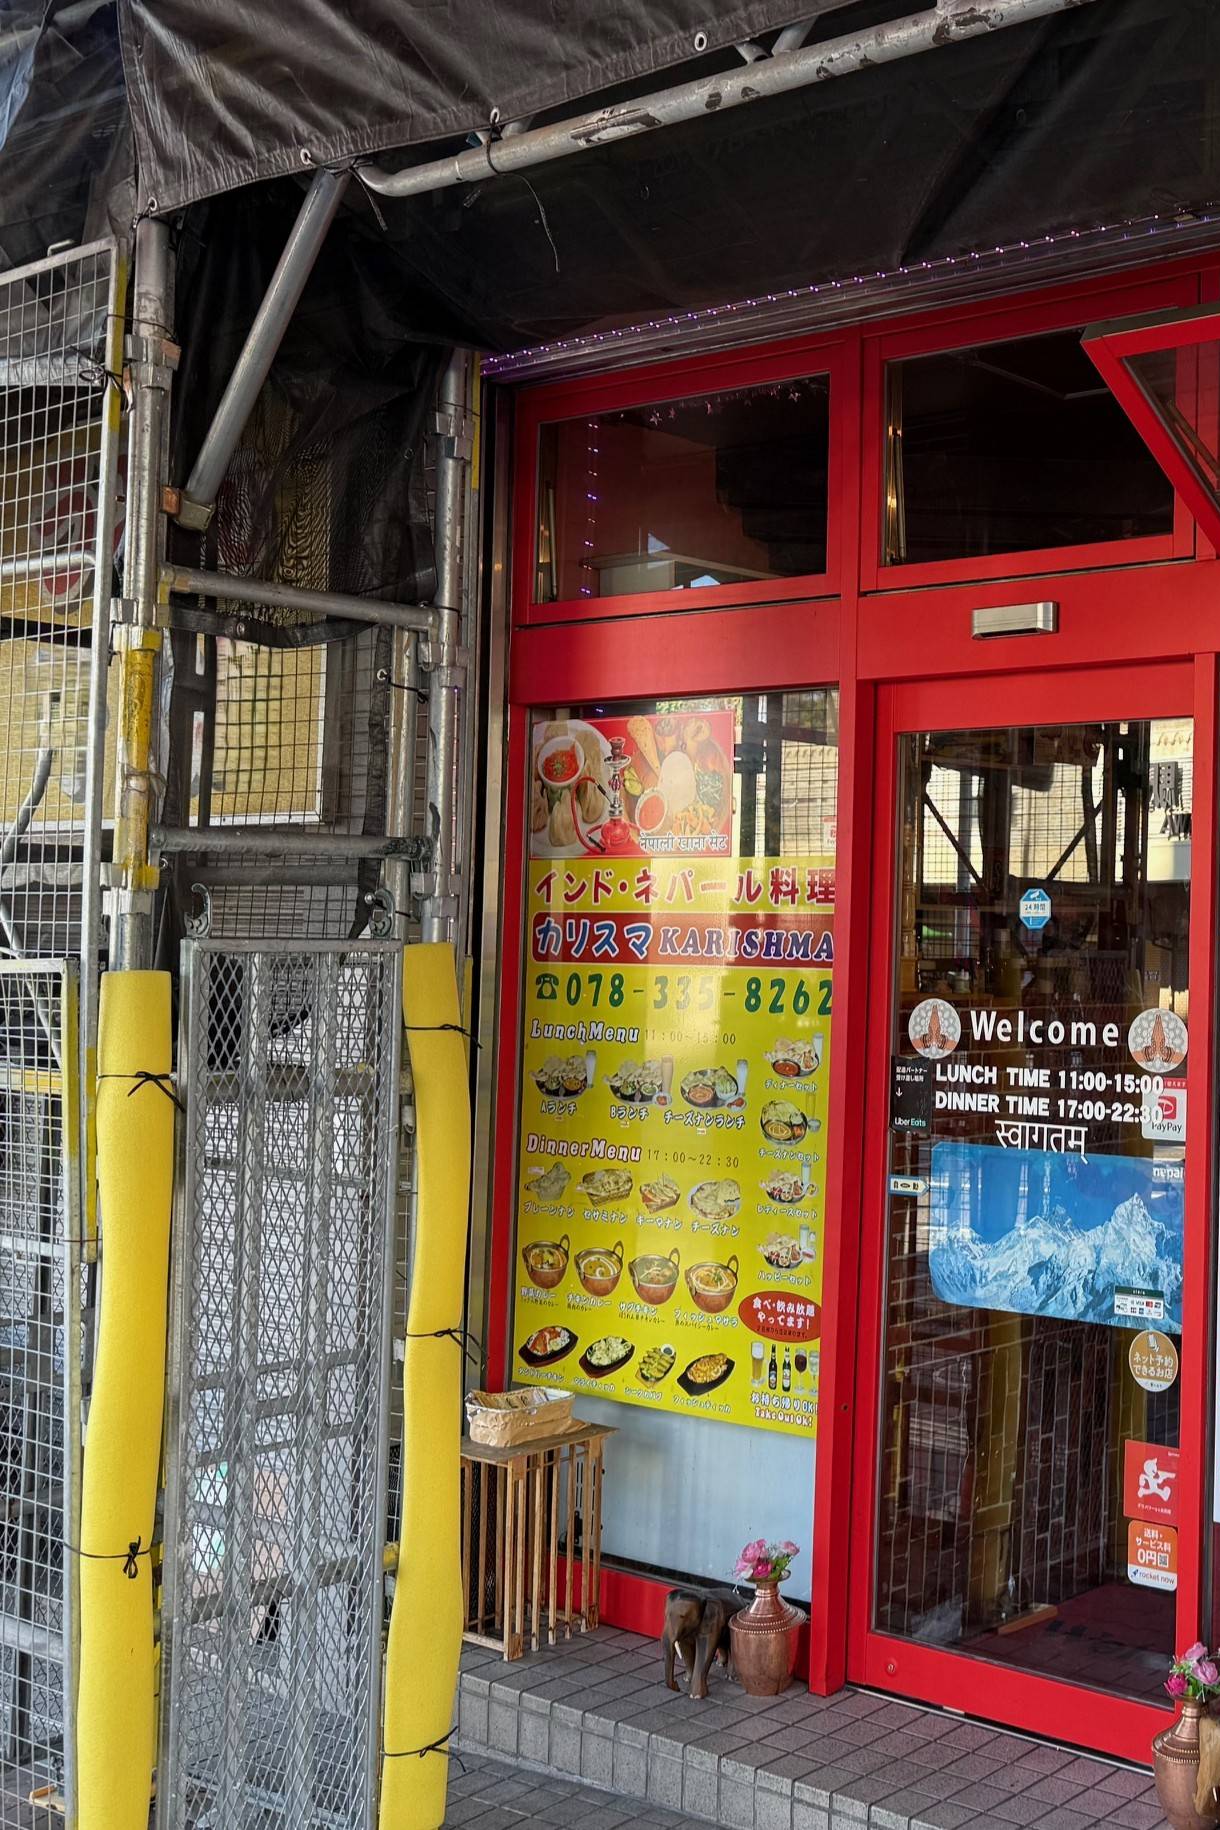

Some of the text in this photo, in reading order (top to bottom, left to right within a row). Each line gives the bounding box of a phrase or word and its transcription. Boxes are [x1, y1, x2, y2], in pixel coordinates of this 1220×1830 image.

[535, 867, 835, 905] インド・ネパール料理
[535, 917, 834, 961] カリスマ KARISHMA
[566, 972, 832, 1015] 078-335-8262
[970, 1010, 1119, 1048] Welcome
[935, 1064, 1164, 1095] LUNCH TIME 11:00-15:00
[934, 1091, 1164, 1124] DINNER TIME 17:00-22:30
[994, 1119, 1089, 1164] स्वागतम्
